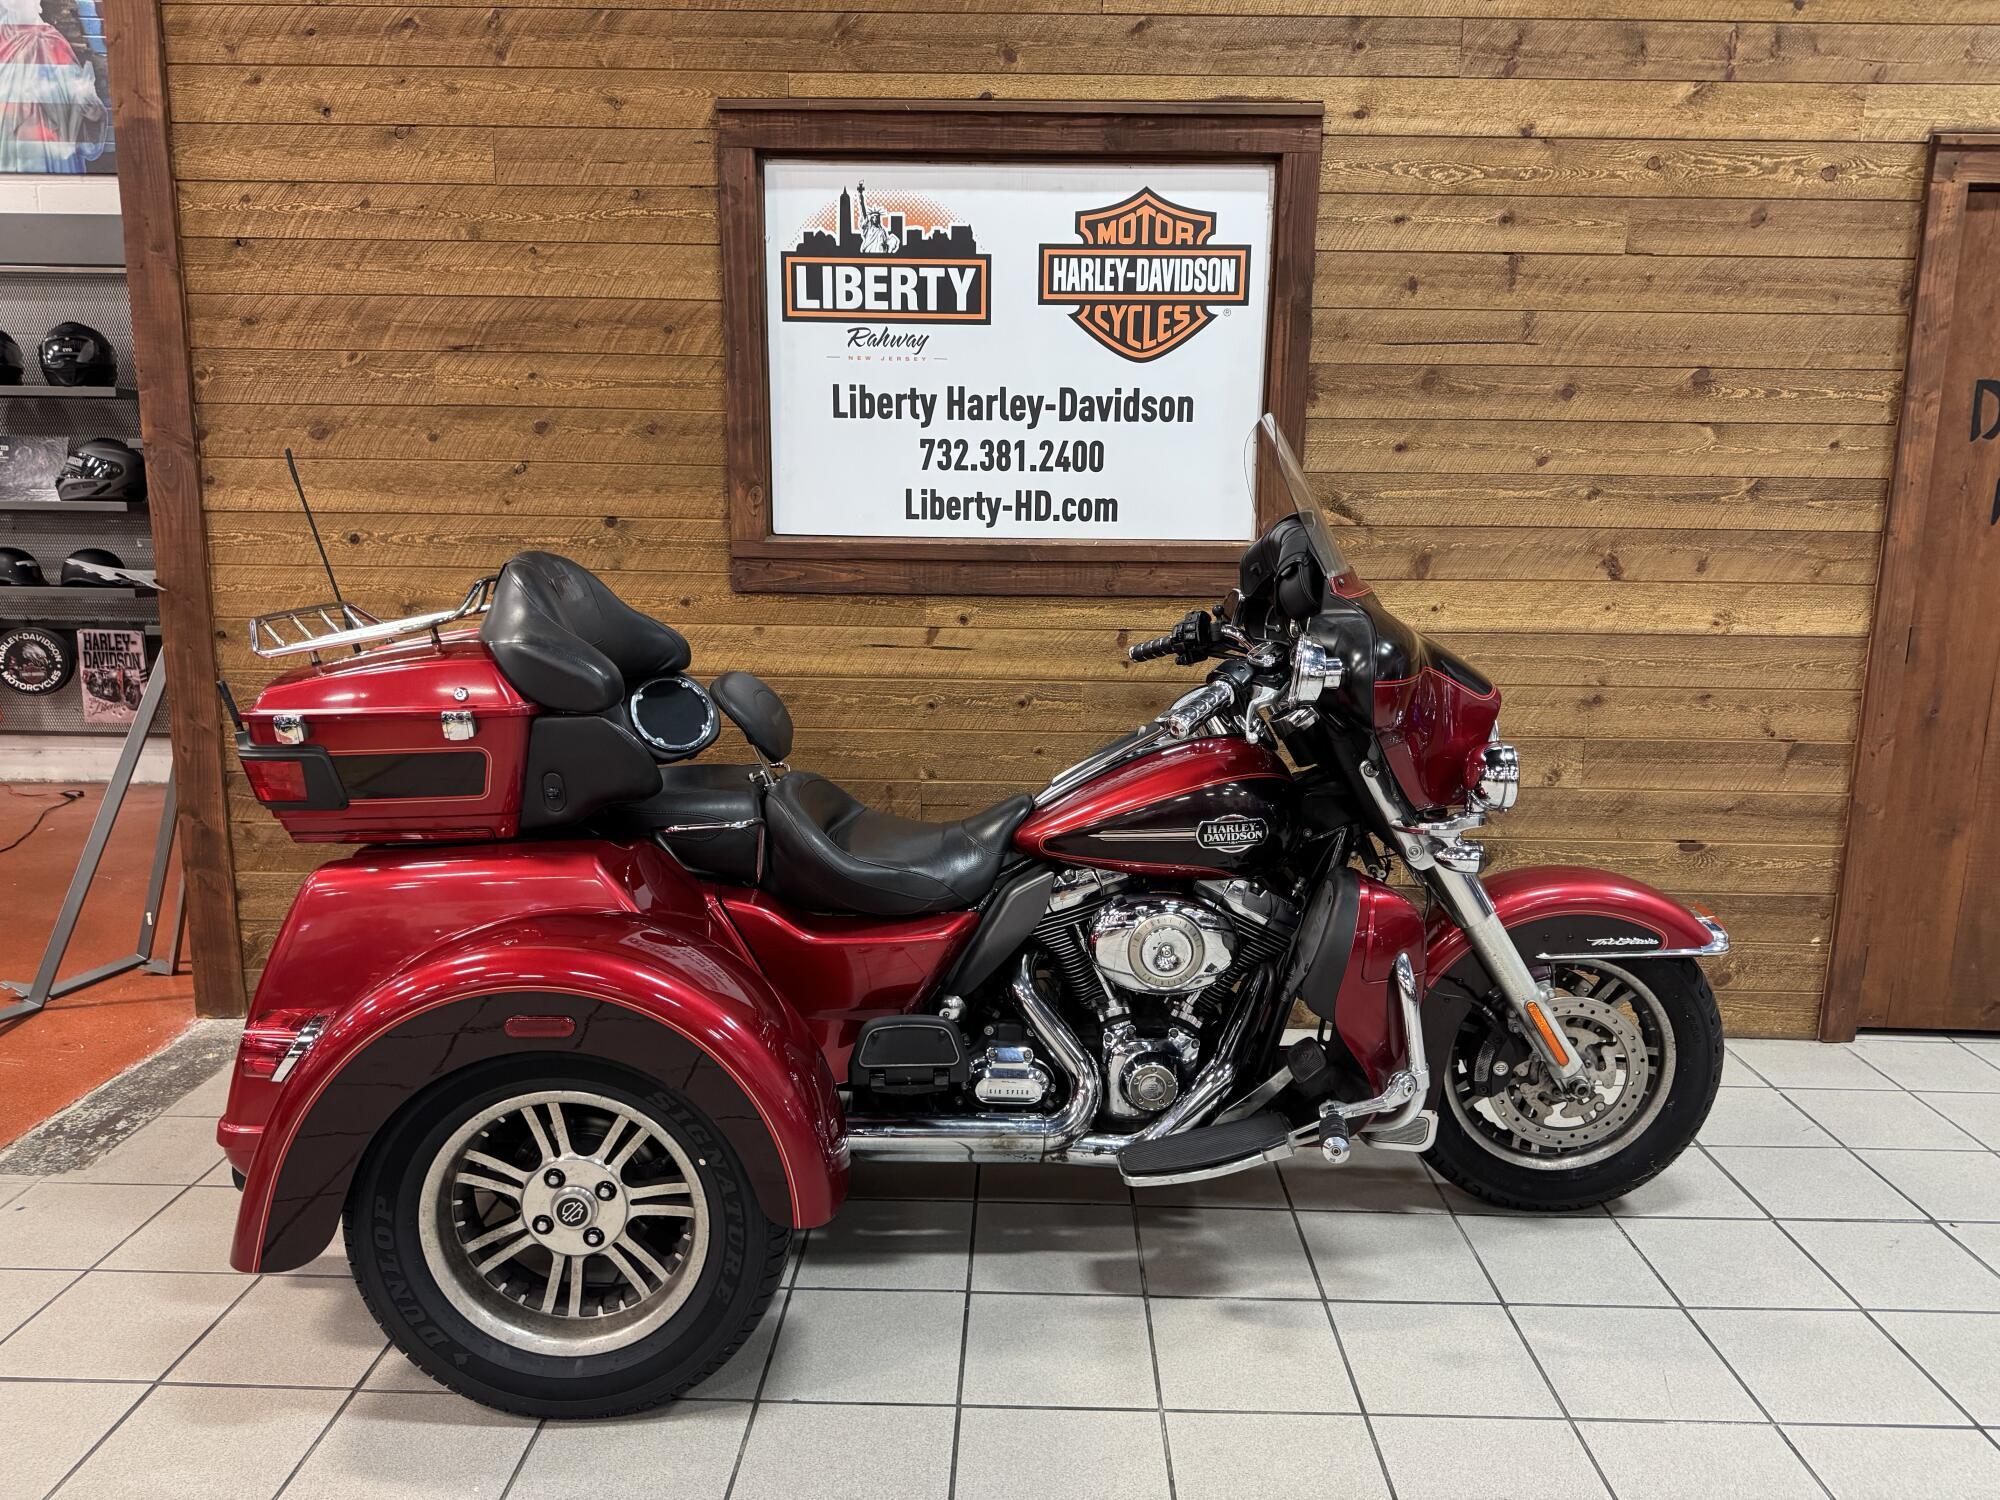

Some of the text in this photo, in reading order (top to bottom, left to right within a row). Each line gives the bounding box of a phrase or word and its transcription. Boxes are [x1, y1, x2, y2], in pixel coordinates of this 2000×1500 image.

[1097, 204, 1194, 245] MOTOR
[796, 265, 976, 312] LIBERTY
[1053, 257, 1236, 292] HARLEY-DAVIDSON
[847, 326, 930, 355] Rahway
[1094, 304, 1191, 350] CYCLES
[832, 384, 1194, 429] Liberty Harley-Davidson
[920, 438, 1105, 472] 732.381.2400
[905, 488, 1118, 528] Liberty-HD.com
[0, 632, 63, 663] HARLEY-DAVIDSON
[83, 632, 137, 651] HARLEY-
[83, 651, 142, 669] DAVIDSON
[1, 670, 61, 691] MOTORCYCLES
[1203, 830, 1263, 842] DAVIDSON
[1207, 823, 1260, 834] HARLEY-
[374, 1195, 452, 1347] DUNLOP
